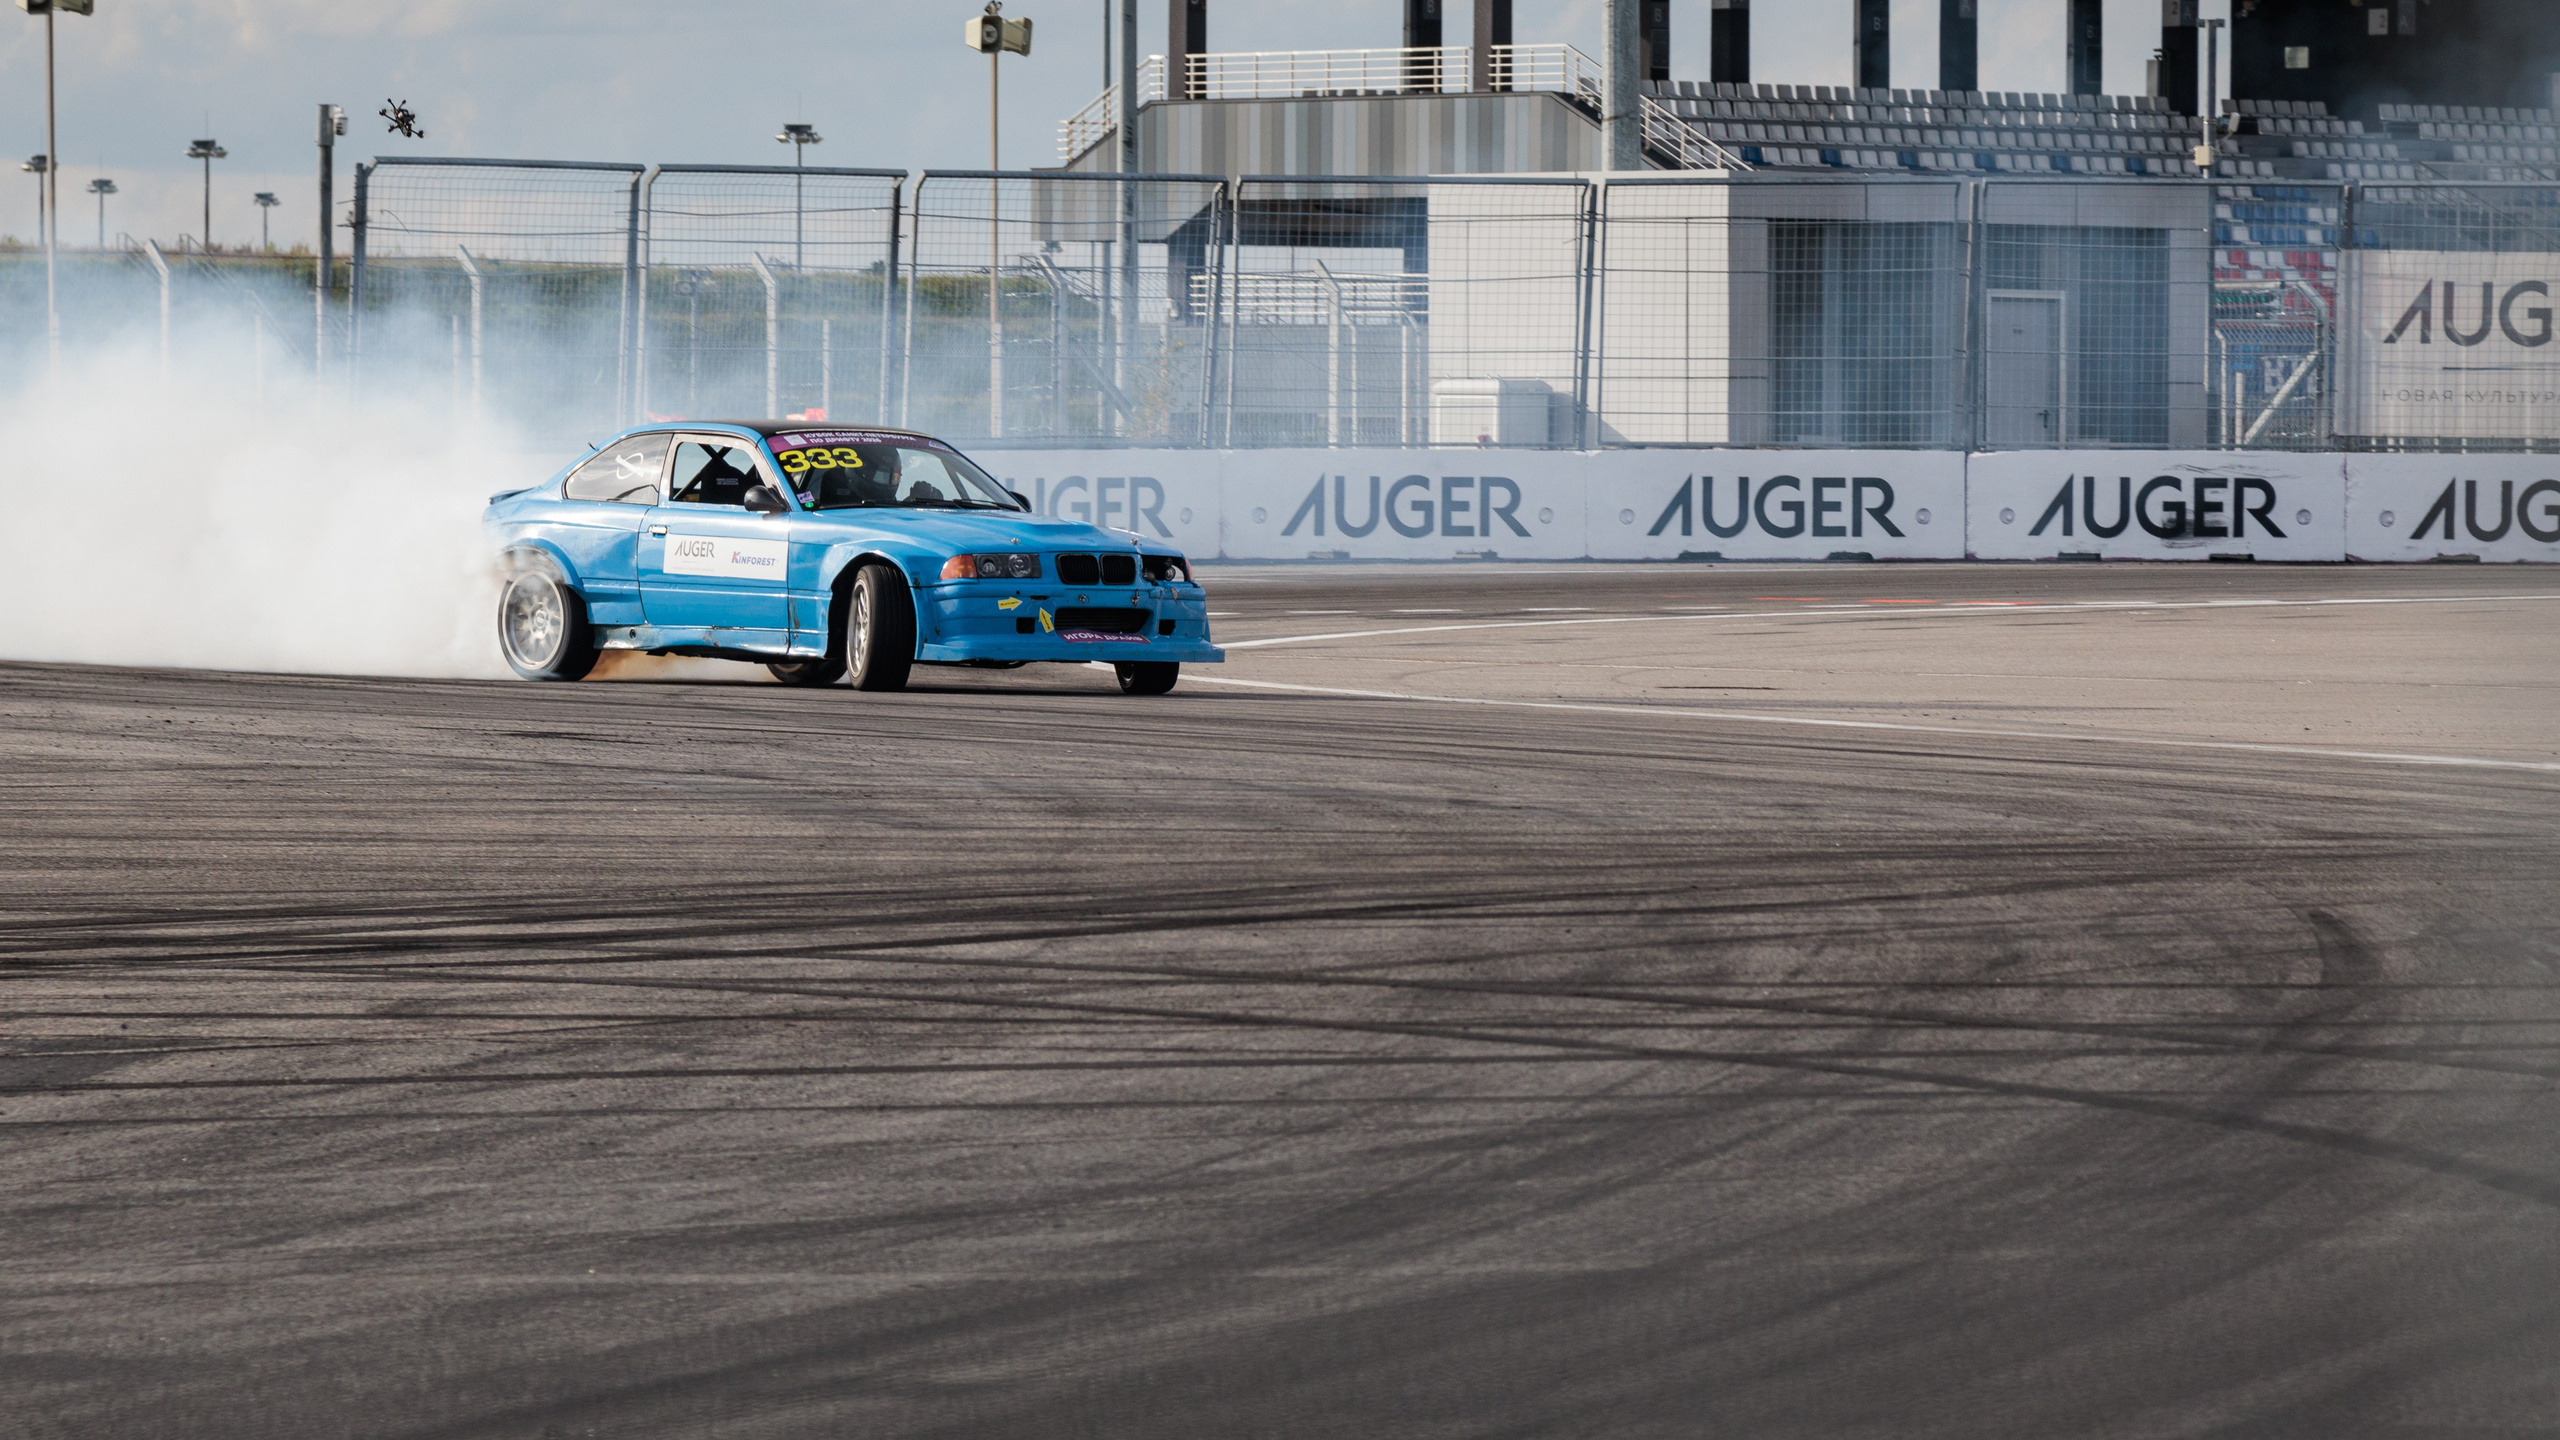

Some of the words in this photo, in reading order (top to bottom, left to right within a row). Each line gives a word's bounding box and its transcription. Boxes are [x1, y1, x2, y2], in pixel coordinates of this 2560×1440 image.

[2382, 388, 2454, 403] НОВАЯ
[2464, 389, 2560, 404] КУЛЬТУР
[779, 448, 863, 473] 333
[994, 475, 1174, 538] UGER
[1280, 472, 1532, 538] AUGER
[1646, 472, 1906, 538] AUGER
[2028, 472, 2288, 539] AUGER
[674, 540, 715, 558] AUGER
[731, 551, 776, 566] KINFOREST
[1063, 632, 1104, 640] ИГОРА
